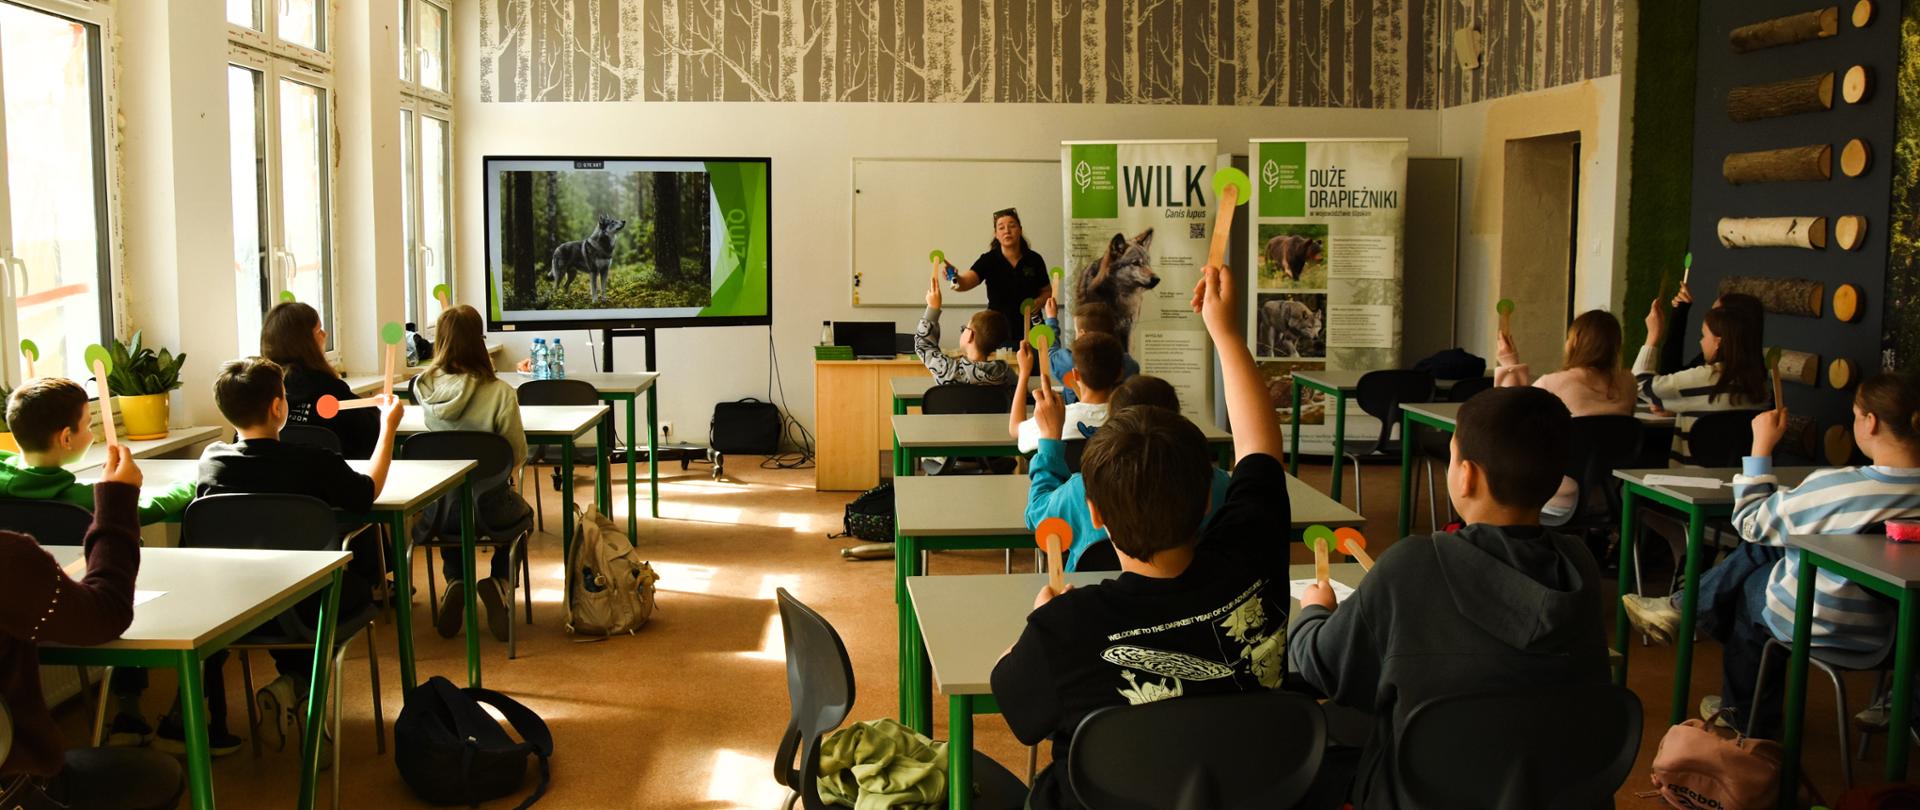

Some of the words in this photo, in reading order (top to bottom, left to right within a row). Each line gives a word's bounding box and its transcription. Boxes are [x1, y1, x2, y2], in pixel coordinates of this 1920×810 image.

[1123, 165, 1206, 207] WILK
[1310, 165, 1346, 188] DUŻE
[1309, 186, 1398, 209] DRAPIEŻNIKI
[1165, 208, 1185, 218] Canis
[1187, 208, 1206, 219] lupus
[726, 209, 747, 259] QUIZ
[1108, 629, 1141, 641] WELCOME
[1151, 624, 1165, 633] THE
[1165, 617, 1194, 630] DARKEST
[1195, 612, 1213, 622] YEAR
[1212, 608, 1222, 617] OF
